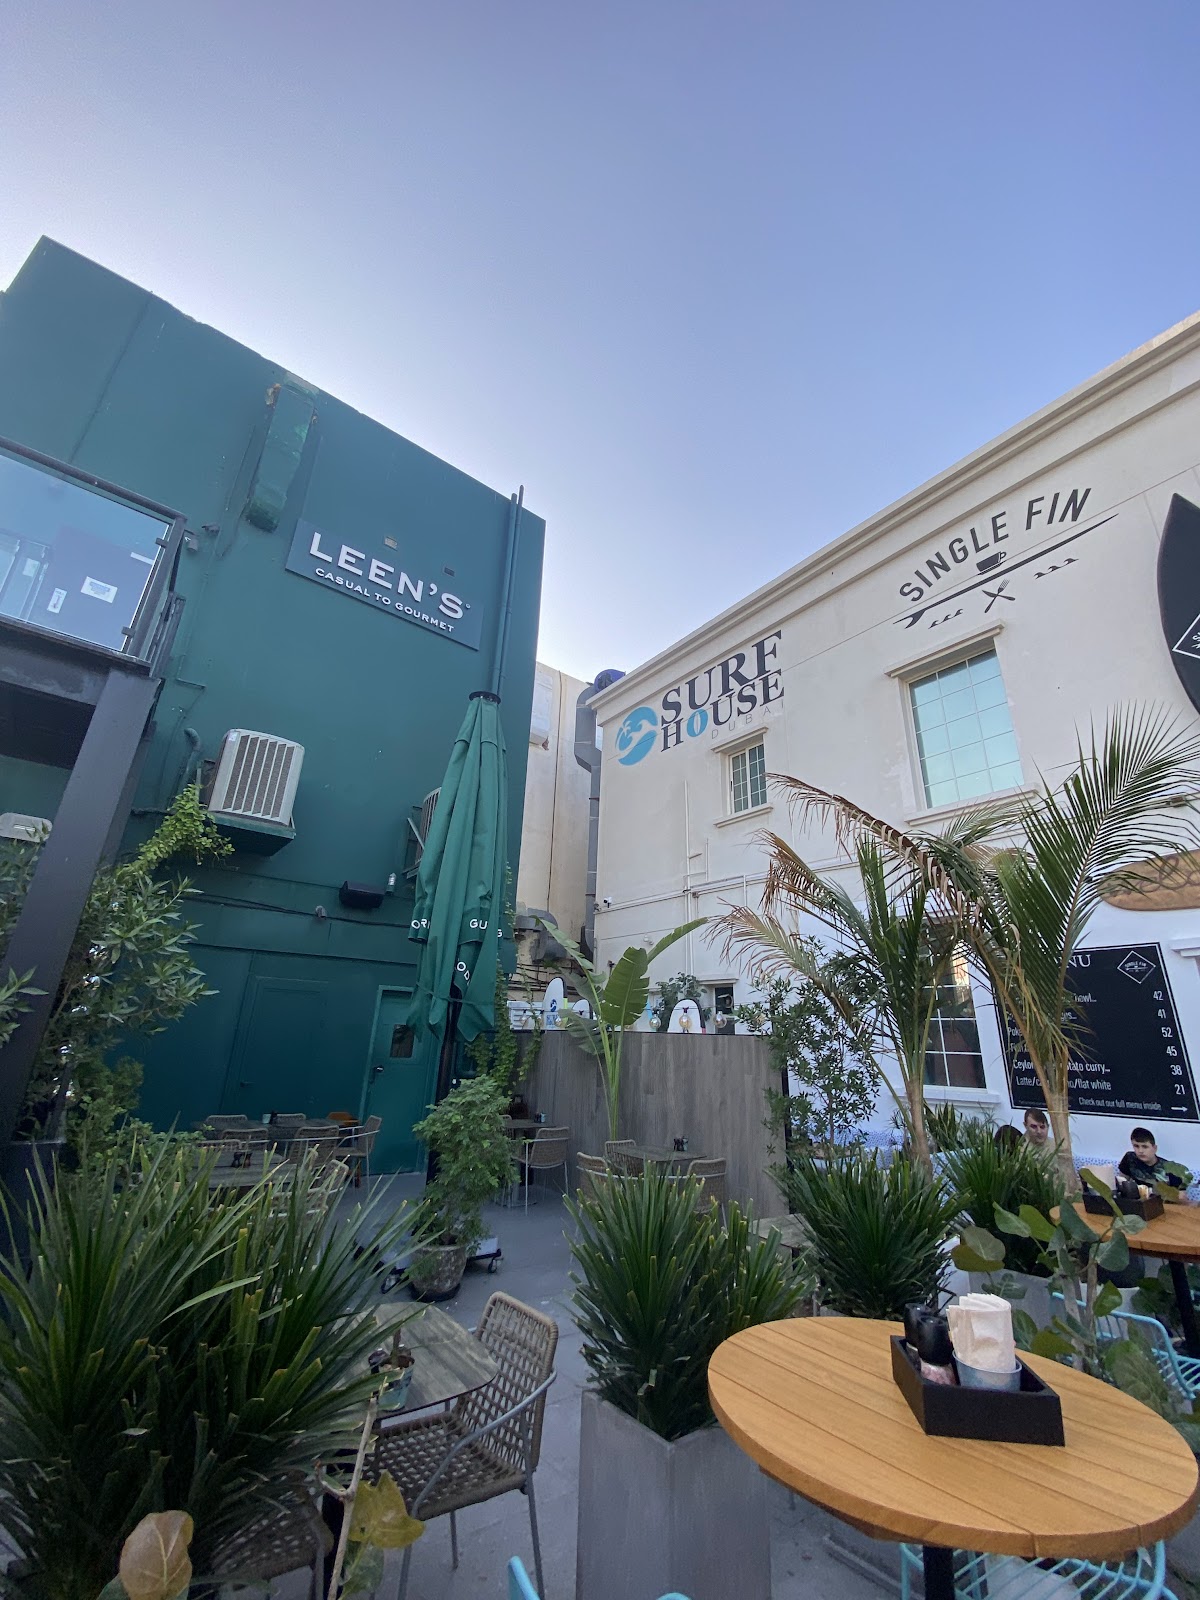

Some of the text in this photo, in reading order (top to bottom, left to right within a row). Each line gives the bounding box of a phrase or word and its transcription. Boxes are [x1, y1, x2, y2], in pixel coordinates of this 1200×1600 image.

[900, 488, 1092, 602] SINGLE FIN
[315, 567, 455, 632] CASUAL TO GOURMET
[661, 630, 782, 727] SURF
[661, 669, 785, 752] HOUSE
[711, 699, 784, 740] DUBAI
[1153, 990, 1164, 1001] 42
[1157, 1008, 1166, 1019] 41
[1162, 1027, 1173, 1038] 52
[1166, 1045, 1178, 1056] 45
[1171, 1065, 1182, 1076] 38
[1090, 1079, 1112, 1091] white
[1174, 1084, 1186, 1095] 21
[1078, 1096, 1095, 1106] Check
